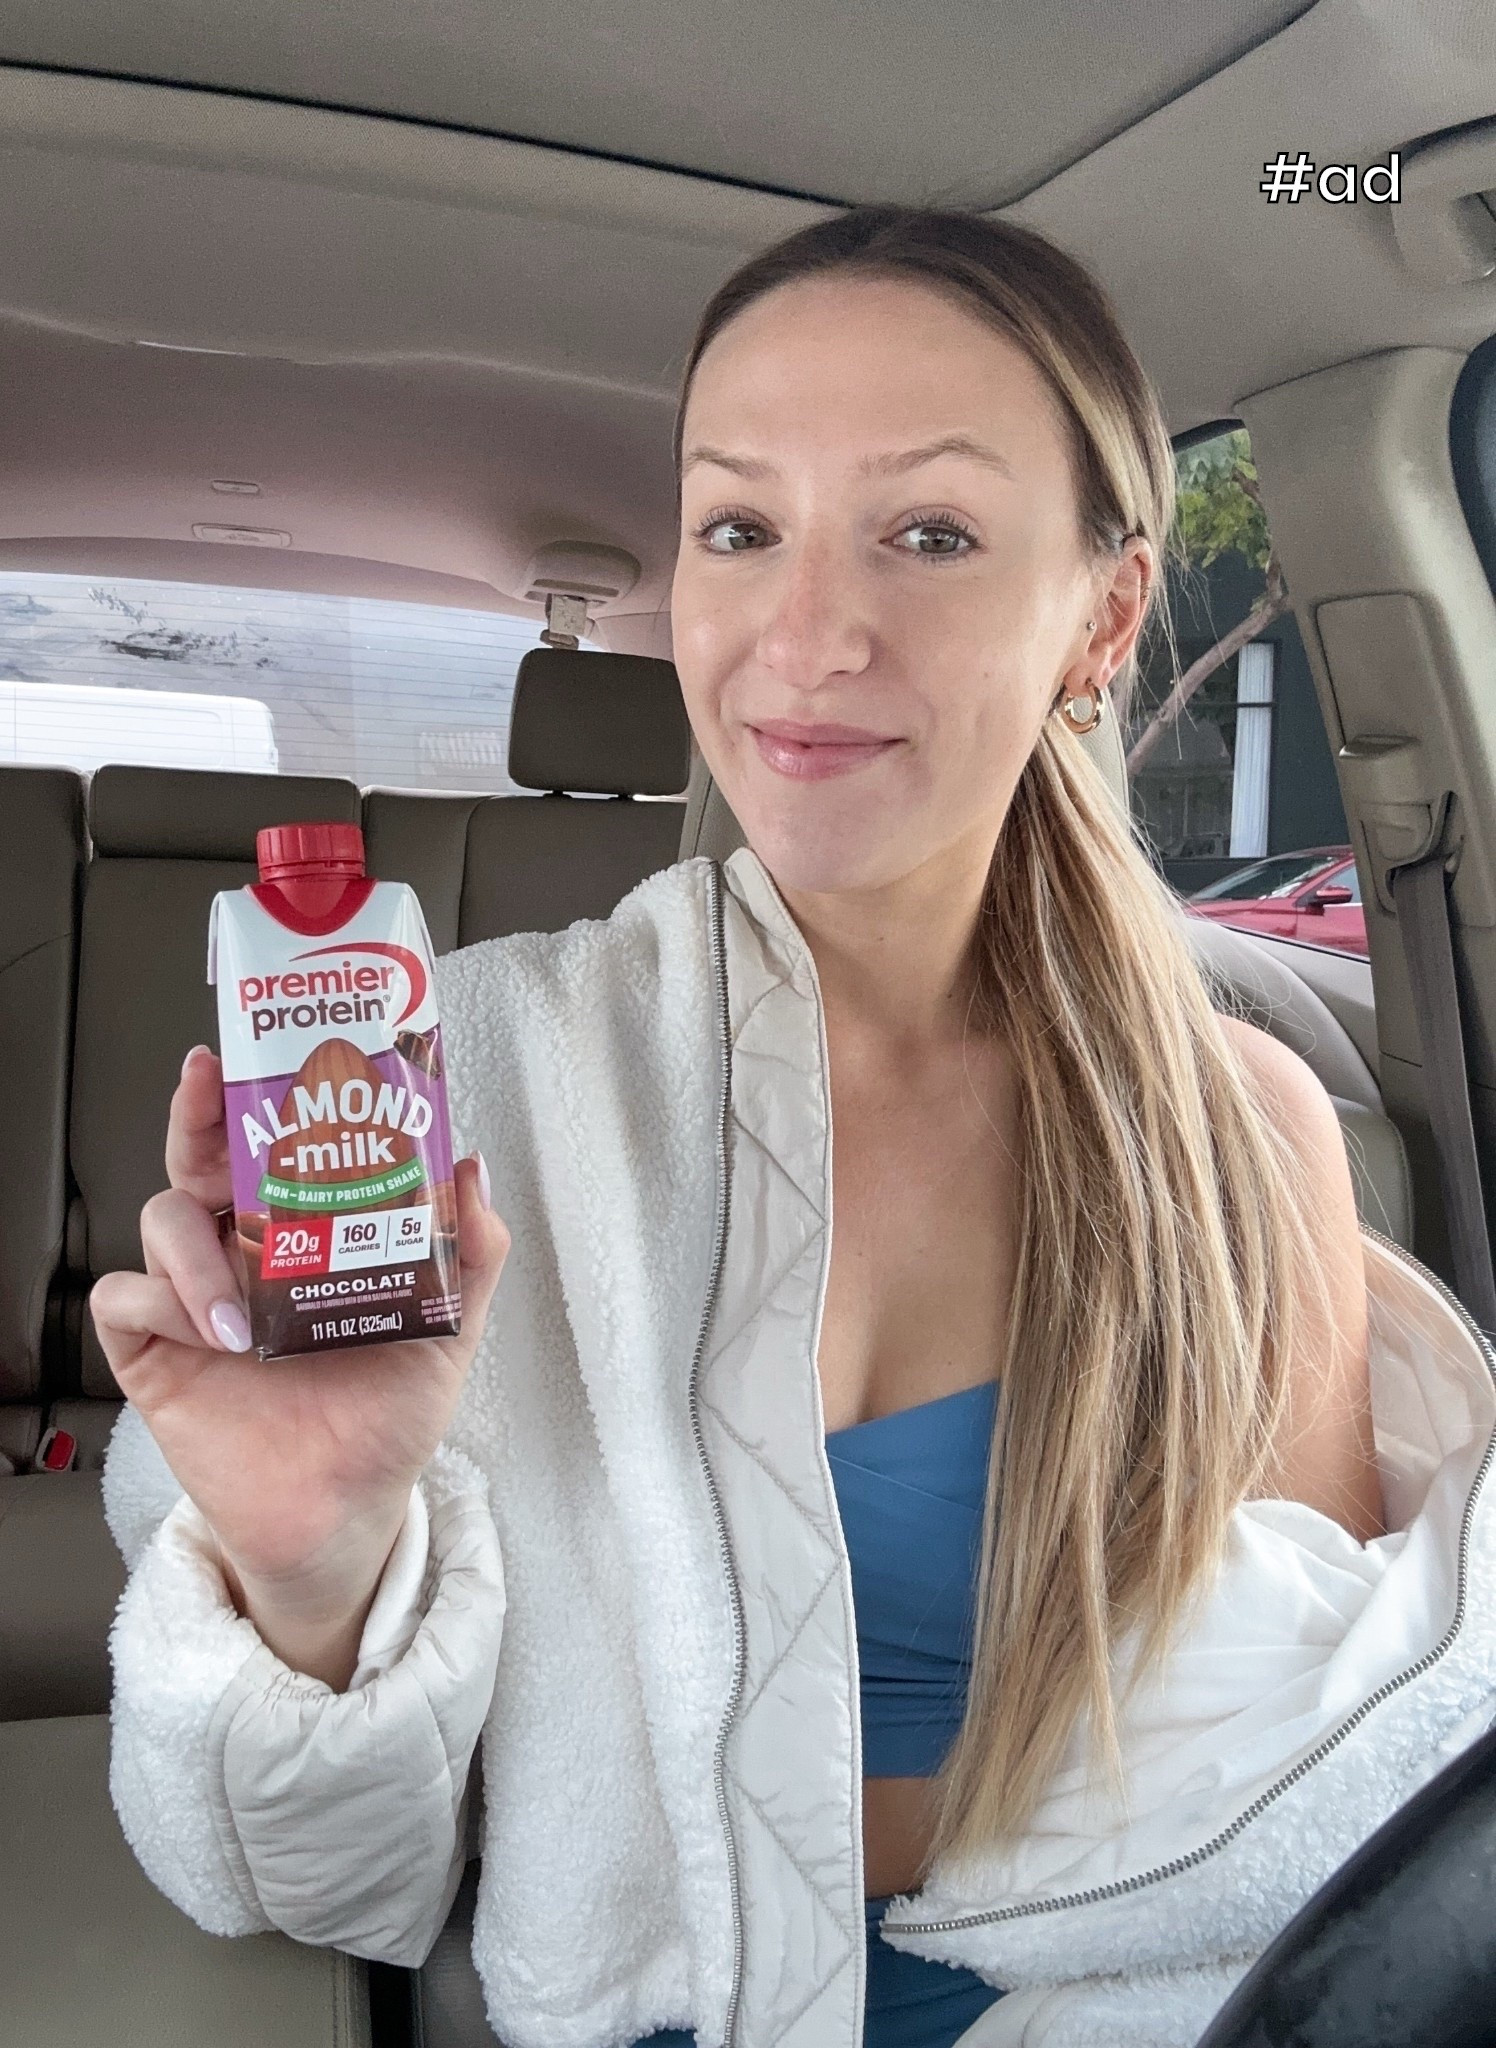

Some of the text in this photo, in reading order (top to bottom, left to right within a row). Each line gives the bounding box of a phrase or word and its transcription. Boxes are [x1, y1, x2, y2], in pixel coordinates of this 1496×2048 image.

[238, 960, 395, 1012] premier
[251, 992, 386, 1041] protein
[241, 1078, 433, 1159] ALMOND
[280, 1131, 397, 1173] -milk
[264, 1165, 422, 1203] NON-DAIRY PROTEIN SHAKE
[342, 1222, 377, 1244] 160
[401, 1217, 422, 1236] 5g
[274, 1229, 320, 1257] 20g
[338, 1242, 381, 1254] CALORIES
[395, 1236, 424, 1247] SUGAR
[270, 1254, 322, 1268] PROTEIN
[290, 1271, 416, 1300] CHOCOLATE
[311, 1322, 324, 1341] 11
[325, 1320, 340, 1339] FL
[340, 1318, 357, 1337] OZ
[358, 1310, 403, 1336] (325mL)
